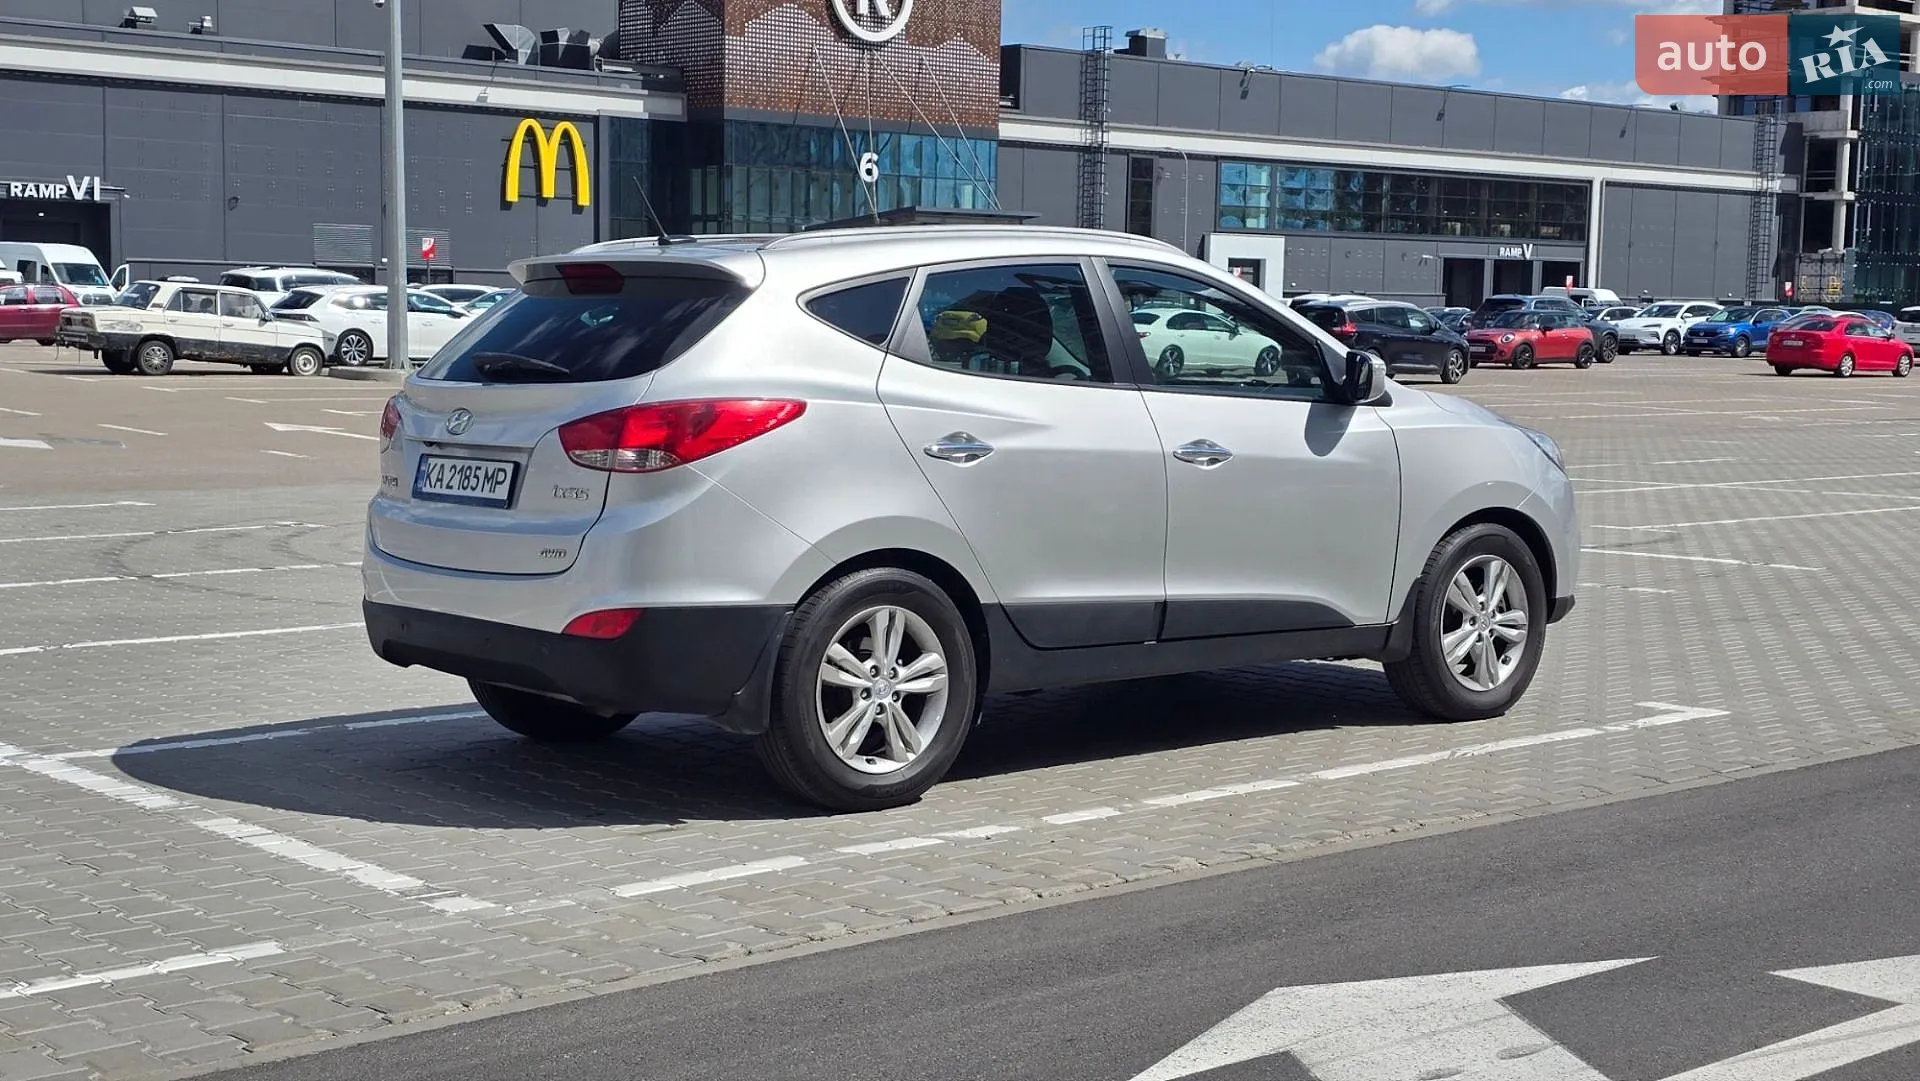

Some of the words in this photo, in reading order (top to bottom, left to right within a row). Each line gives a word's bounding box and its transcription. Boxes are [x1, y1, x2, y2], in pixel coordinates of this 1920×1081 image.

[860, 151, 879, 182] 6
[10, 181, 68, 199] RAMP
[66, 175, 101, 201] VI
[1499, 246, 1523, 258] RAMP
[1522, 243, 1534, 260] V
